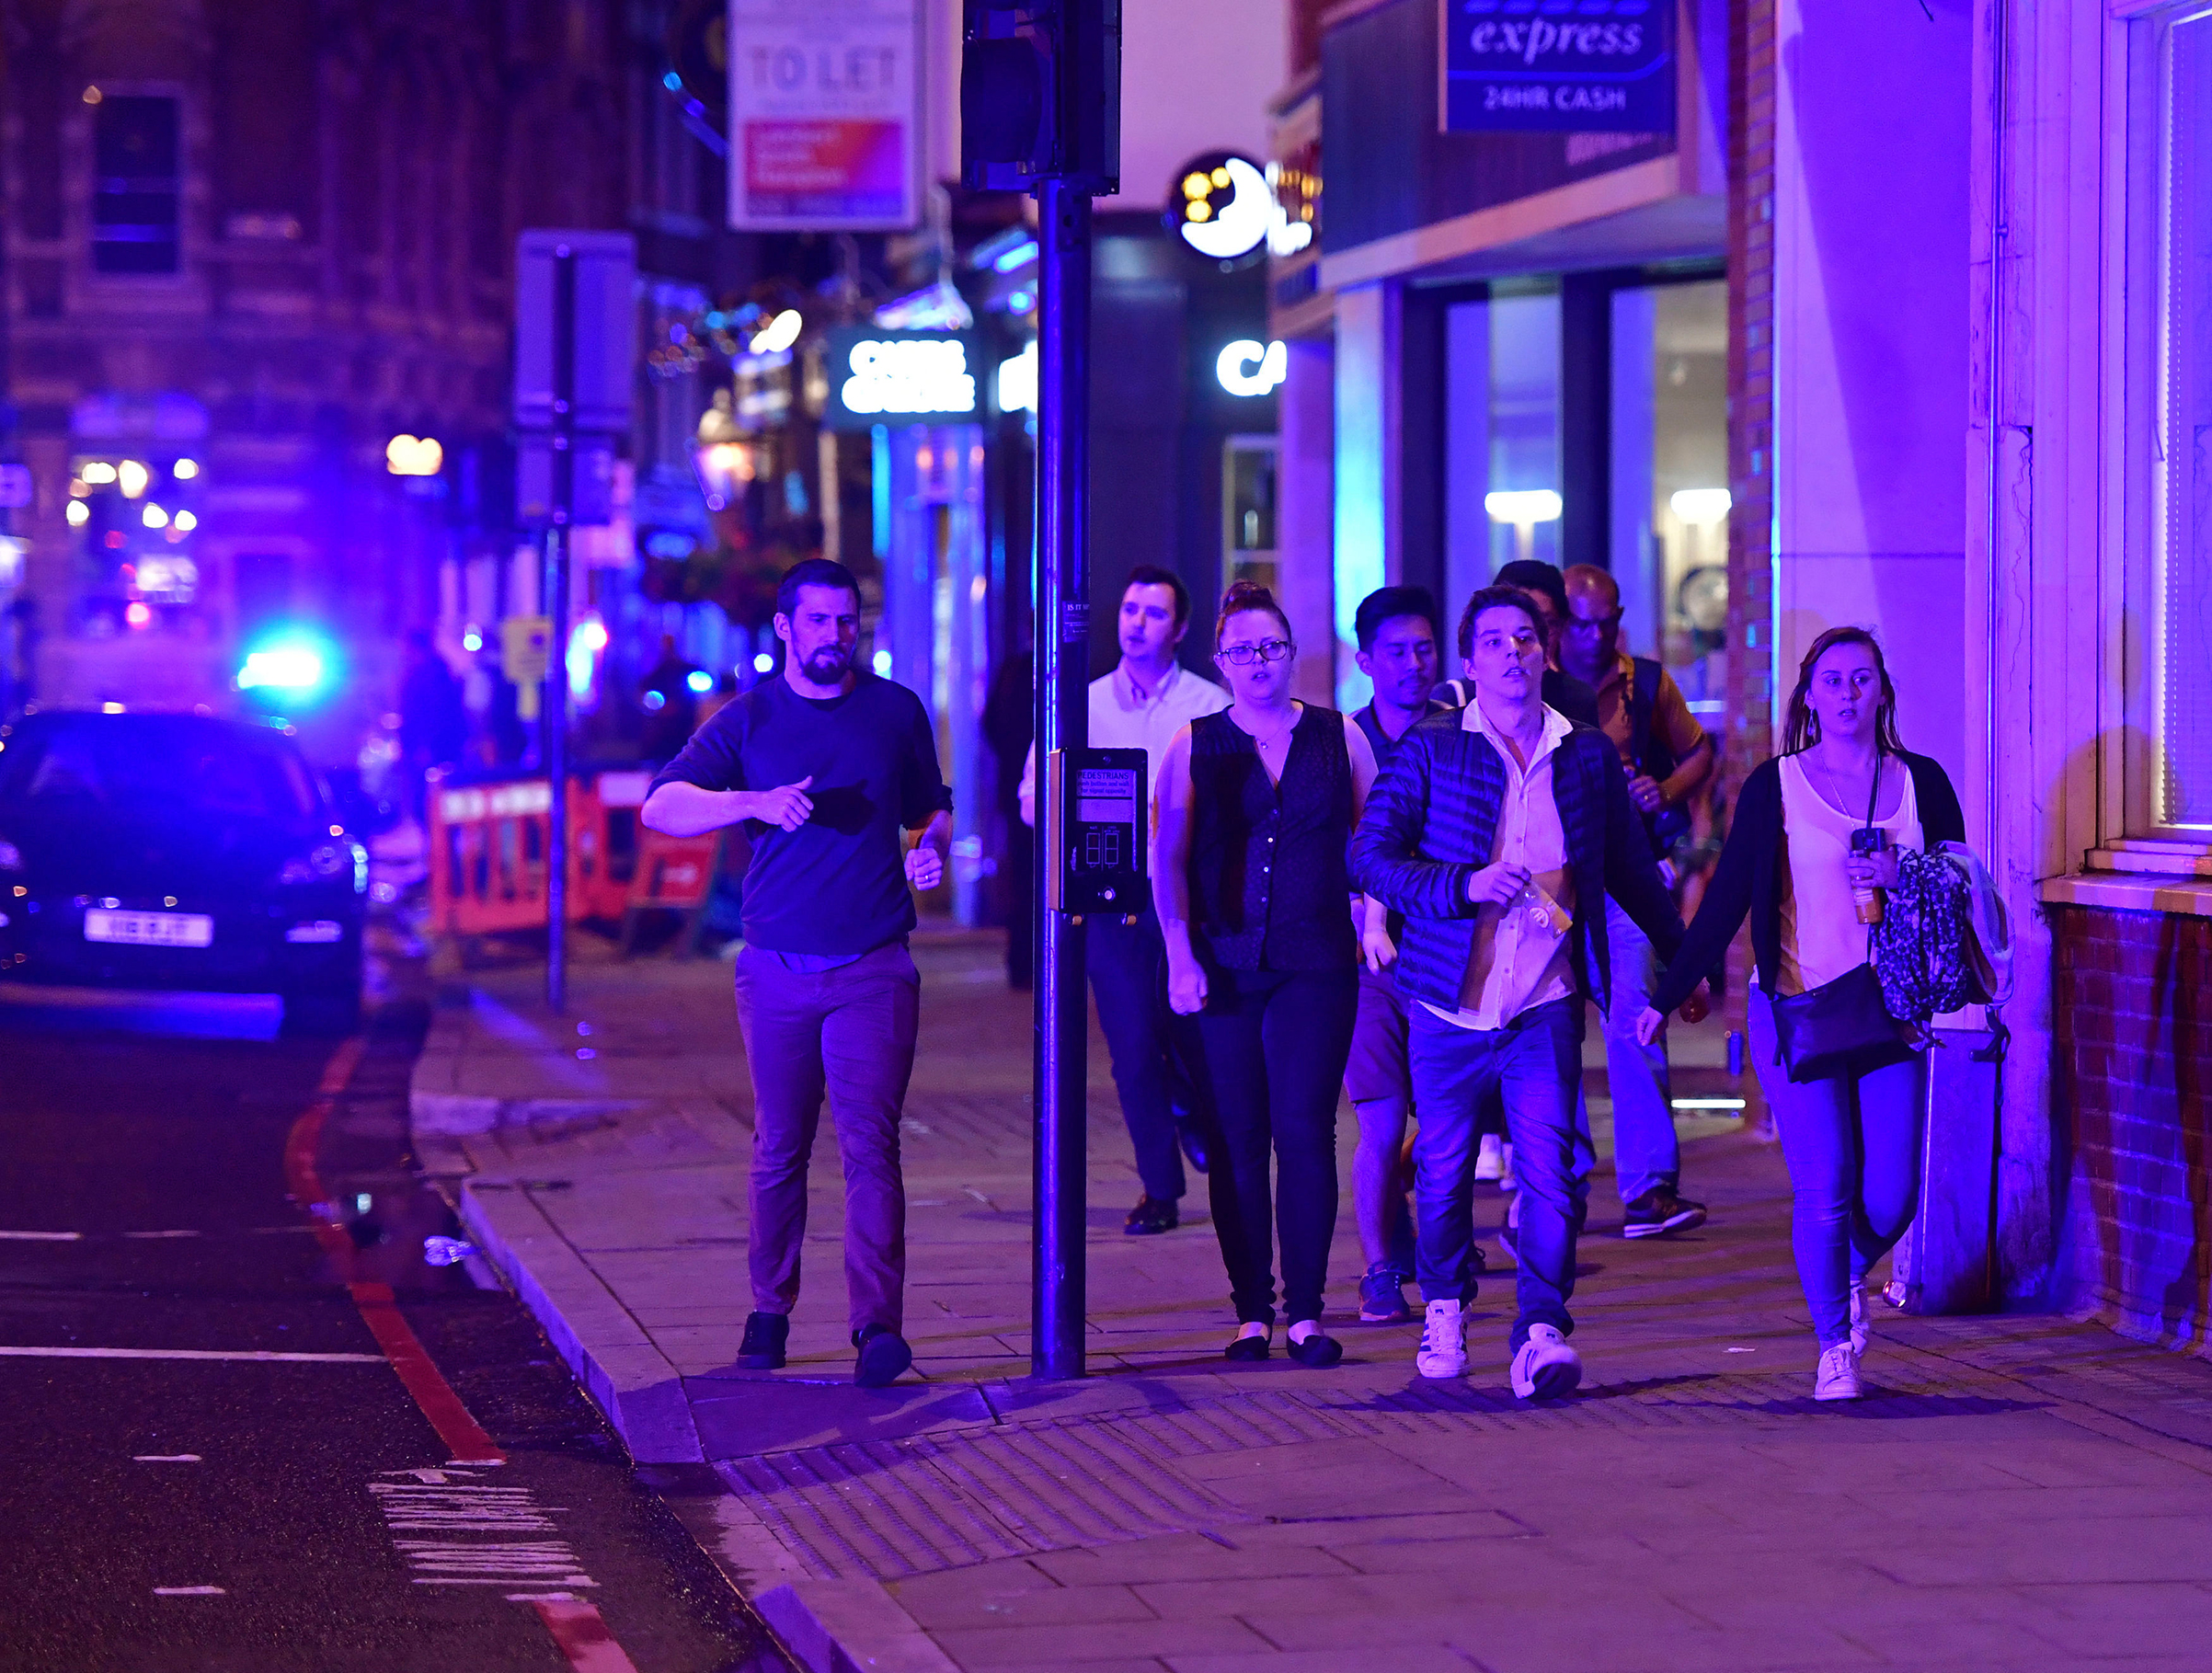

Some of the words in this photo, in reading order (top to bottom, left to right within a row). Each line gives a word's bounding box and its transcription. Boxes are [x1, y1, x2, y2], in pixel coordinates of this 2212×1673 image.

[1470, 17, 1645, 65] express
[749, 46, 808, 92] TO
[815, 46, 899, 92] LET
[1484, 85, 1551, 111] 24HR
[1553, 85, 1627, 111] CASH
[1077, 771, 1129, 780] PEDESTRIANS
